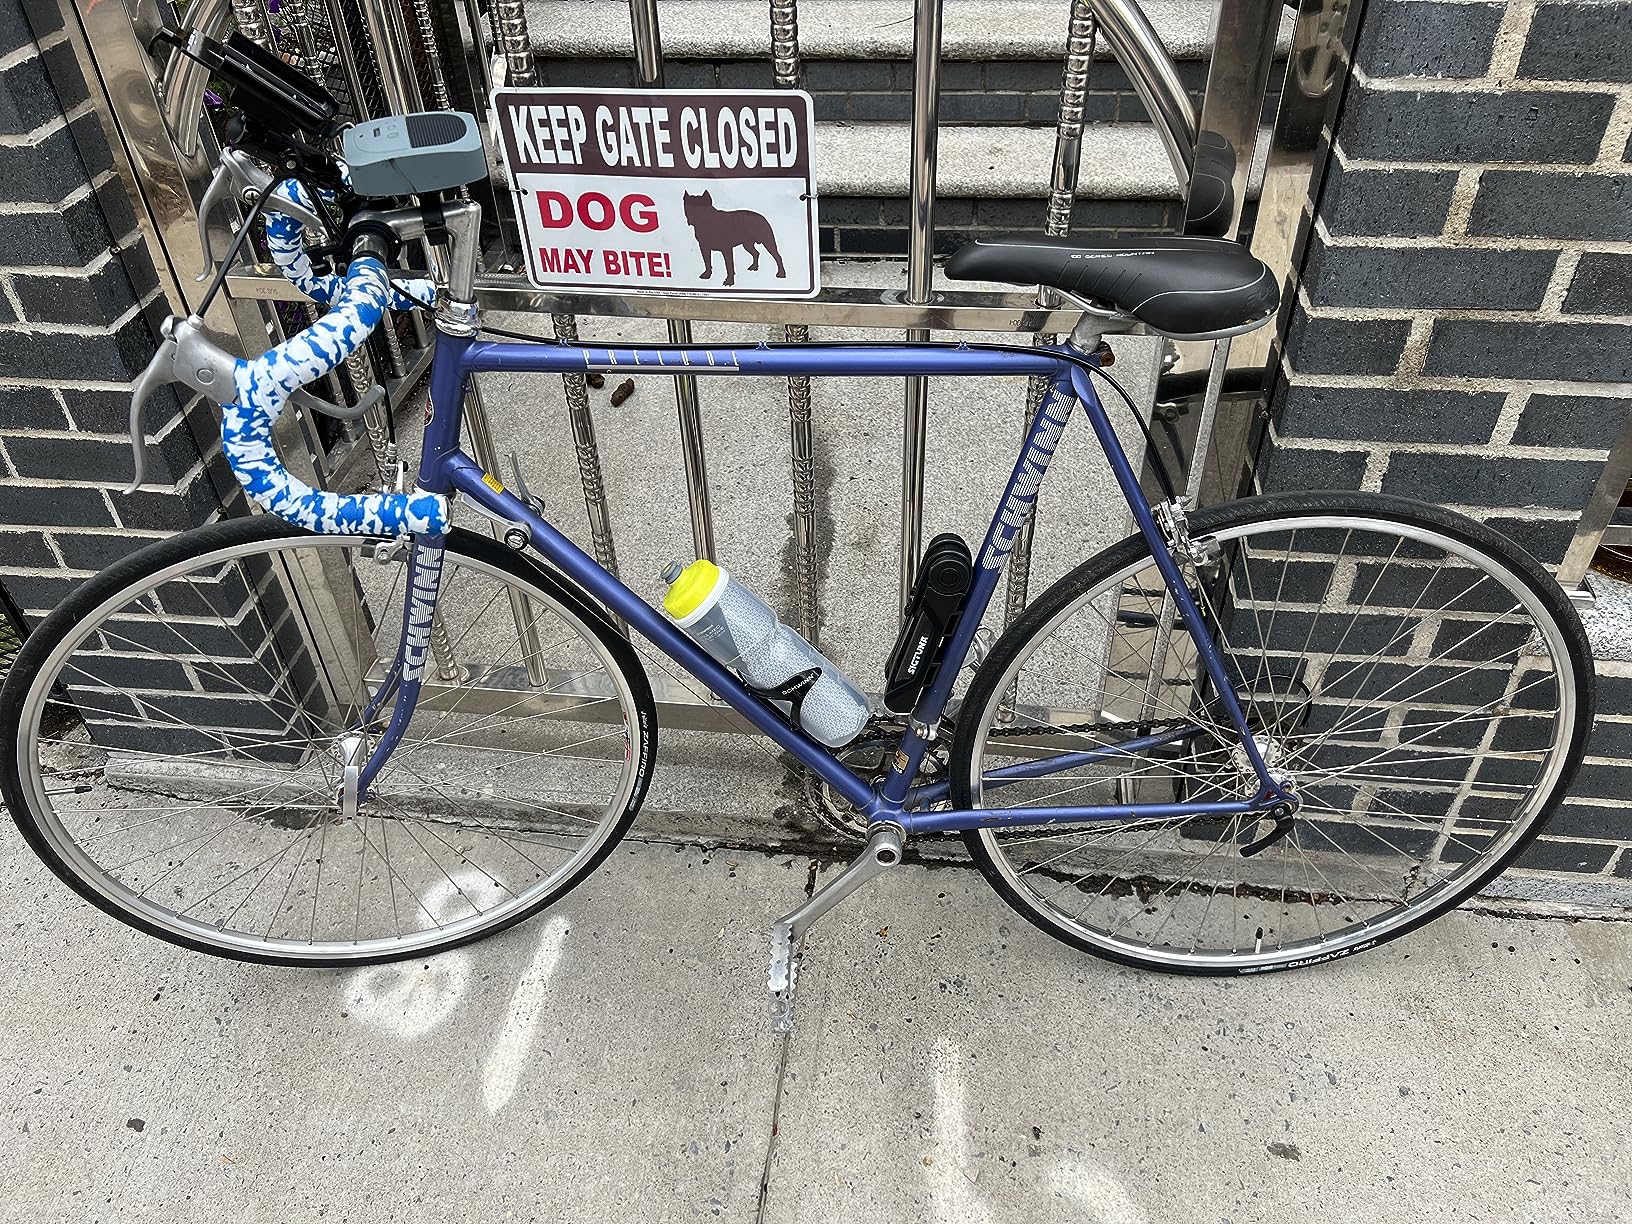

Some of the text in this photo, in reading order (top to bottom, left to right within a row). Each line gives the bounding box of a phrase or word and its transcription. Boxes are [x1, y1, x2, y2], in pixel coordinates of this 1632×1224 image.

[508, 105, 798, 169] KEEP GATE CLOSED
[536, 190, 660, 233] DOG
[539, 247, 672, 278] MAY BITE!
[582, 349, 740, 367] PRELUDE
[981, 386, 1076, 575] SCHWINN
[402, 544, 443, 683] SCHWINN
[781, 673, 815, 696] SCHWINN
